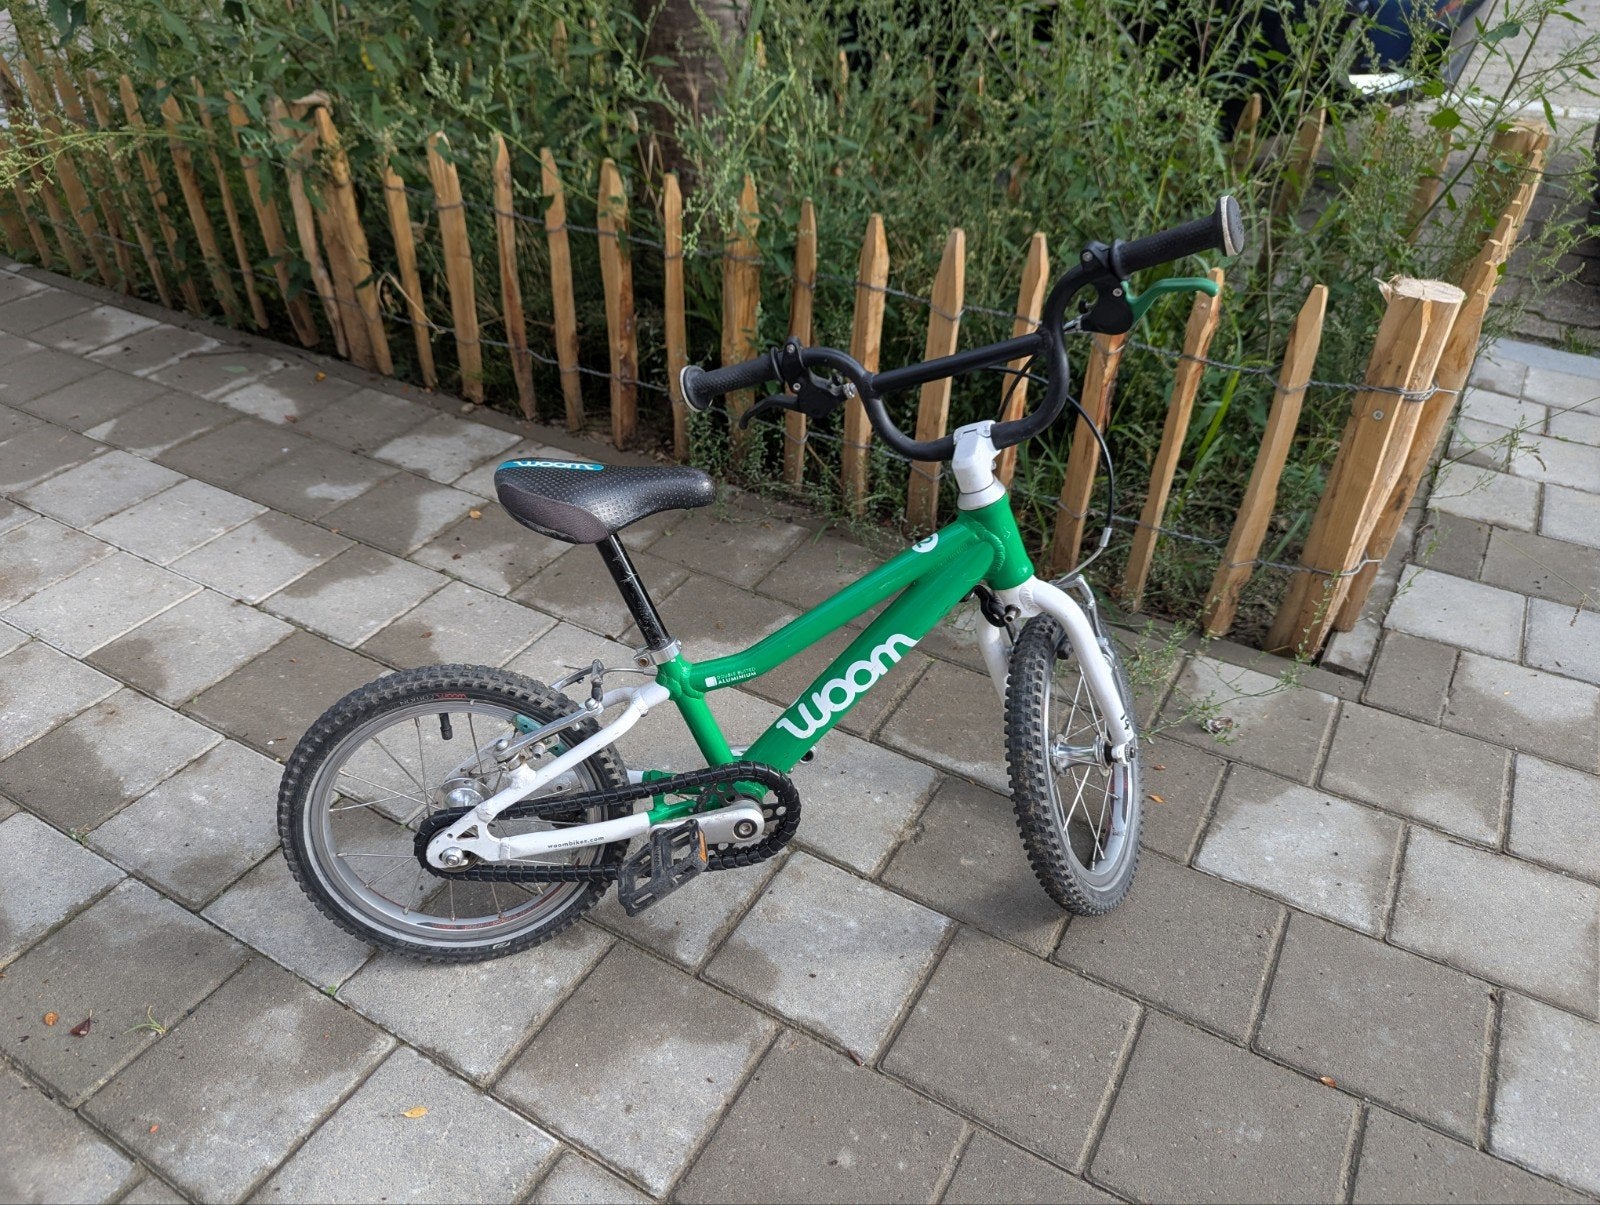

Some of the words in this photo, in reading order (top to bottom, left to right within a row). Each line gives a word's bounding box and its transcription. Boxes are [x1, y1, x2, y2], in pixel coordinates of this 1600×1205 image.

[513, 460, 596, 471] woom
[718, 671, 757, 684] ALUMINIUM
[776, 633, 922, 739] woom
